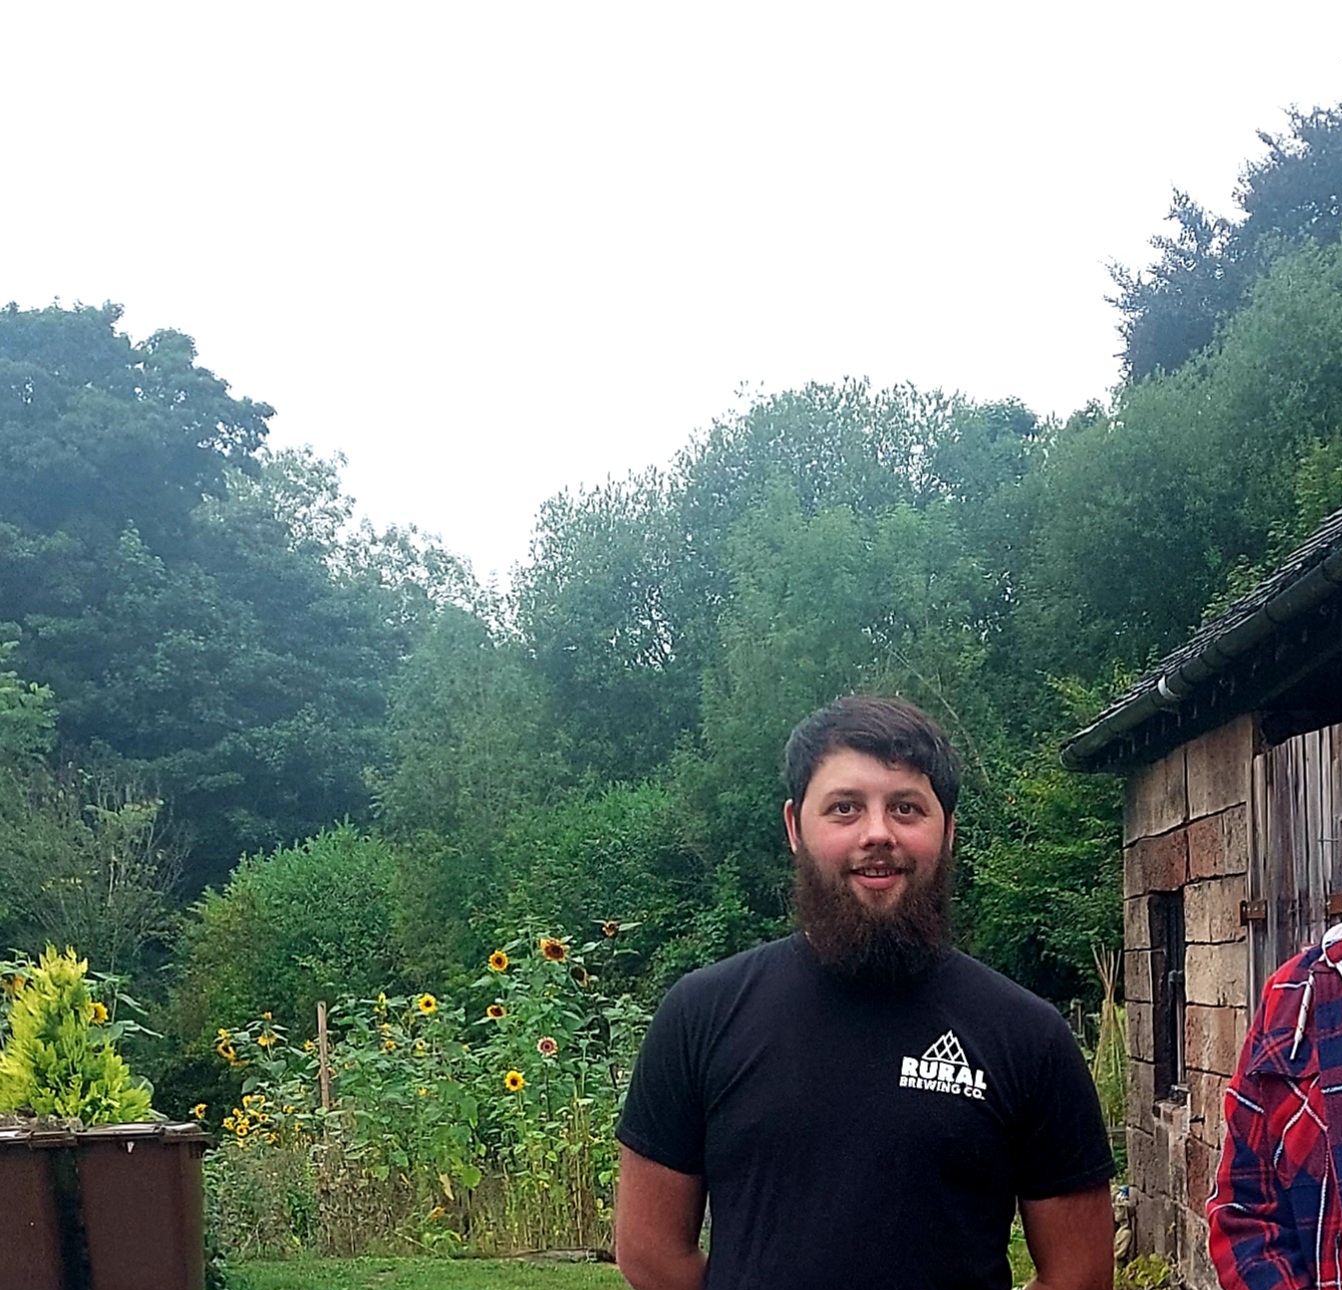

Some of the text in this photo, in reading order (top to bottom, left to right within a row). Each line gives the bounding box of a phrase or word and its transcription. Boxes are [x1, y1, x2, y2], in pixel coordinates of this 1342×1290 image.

[901, 1056, 987, 1090] RURAL
[899, 1076, 986, 1100] BREWING CO.
